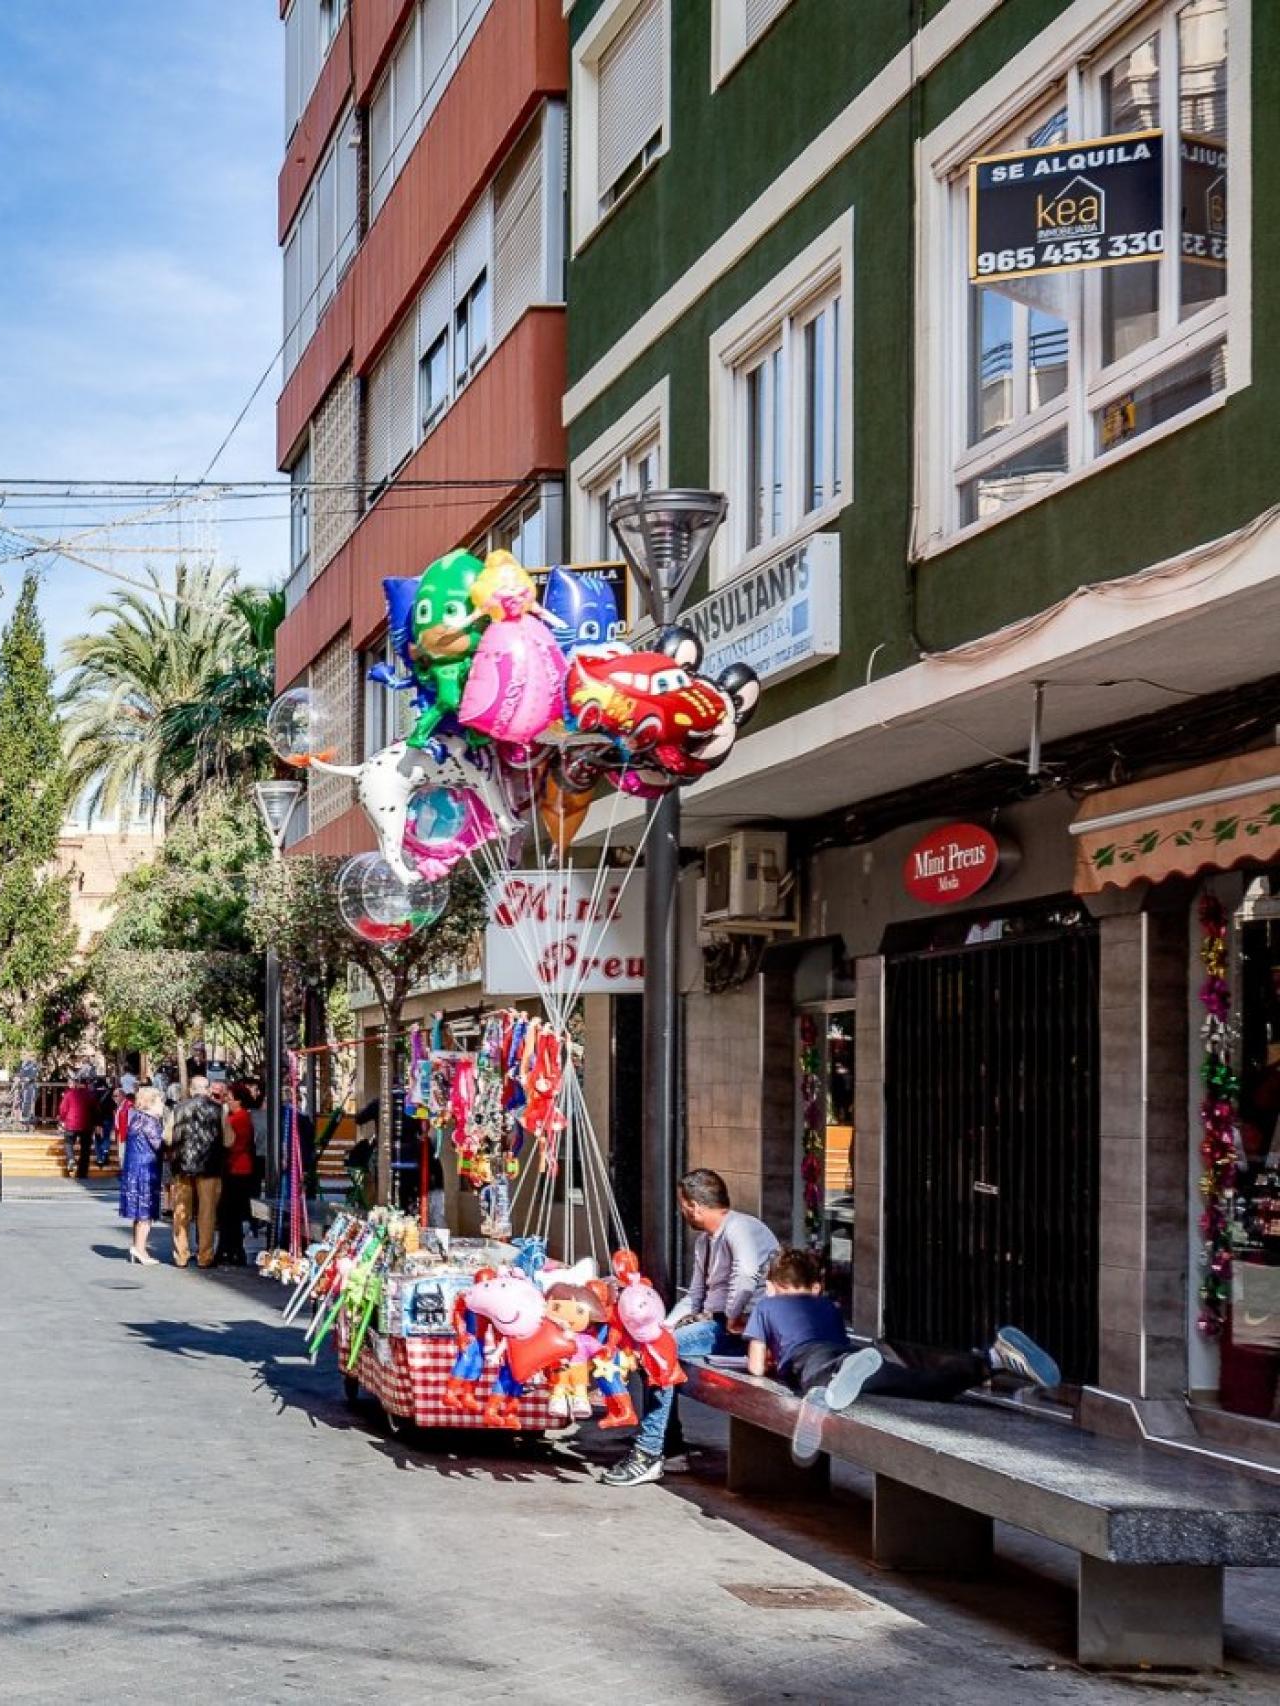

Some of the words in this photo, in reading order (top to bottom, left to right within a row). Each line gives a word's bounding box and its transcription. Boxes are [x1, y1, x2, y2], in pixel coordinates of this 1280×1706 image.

[991, 162, 1024, 182] SE
[1034, 143, 1151, 176] ALQUILA
[1036, 193, 1098, 229] kea
[977, 246, 1035, 274] 965
[1041, 236, 1101, 264] 453
[1107, 229, 1163, 257] 330
[681, 546, 809, 643] NSULTANTS
[914, 846, 946, 880] Mini
[947, 842, 987, 872] Preus
[495, 880, 623, 929] Mini
[537, 934, 646, 983] Preu
